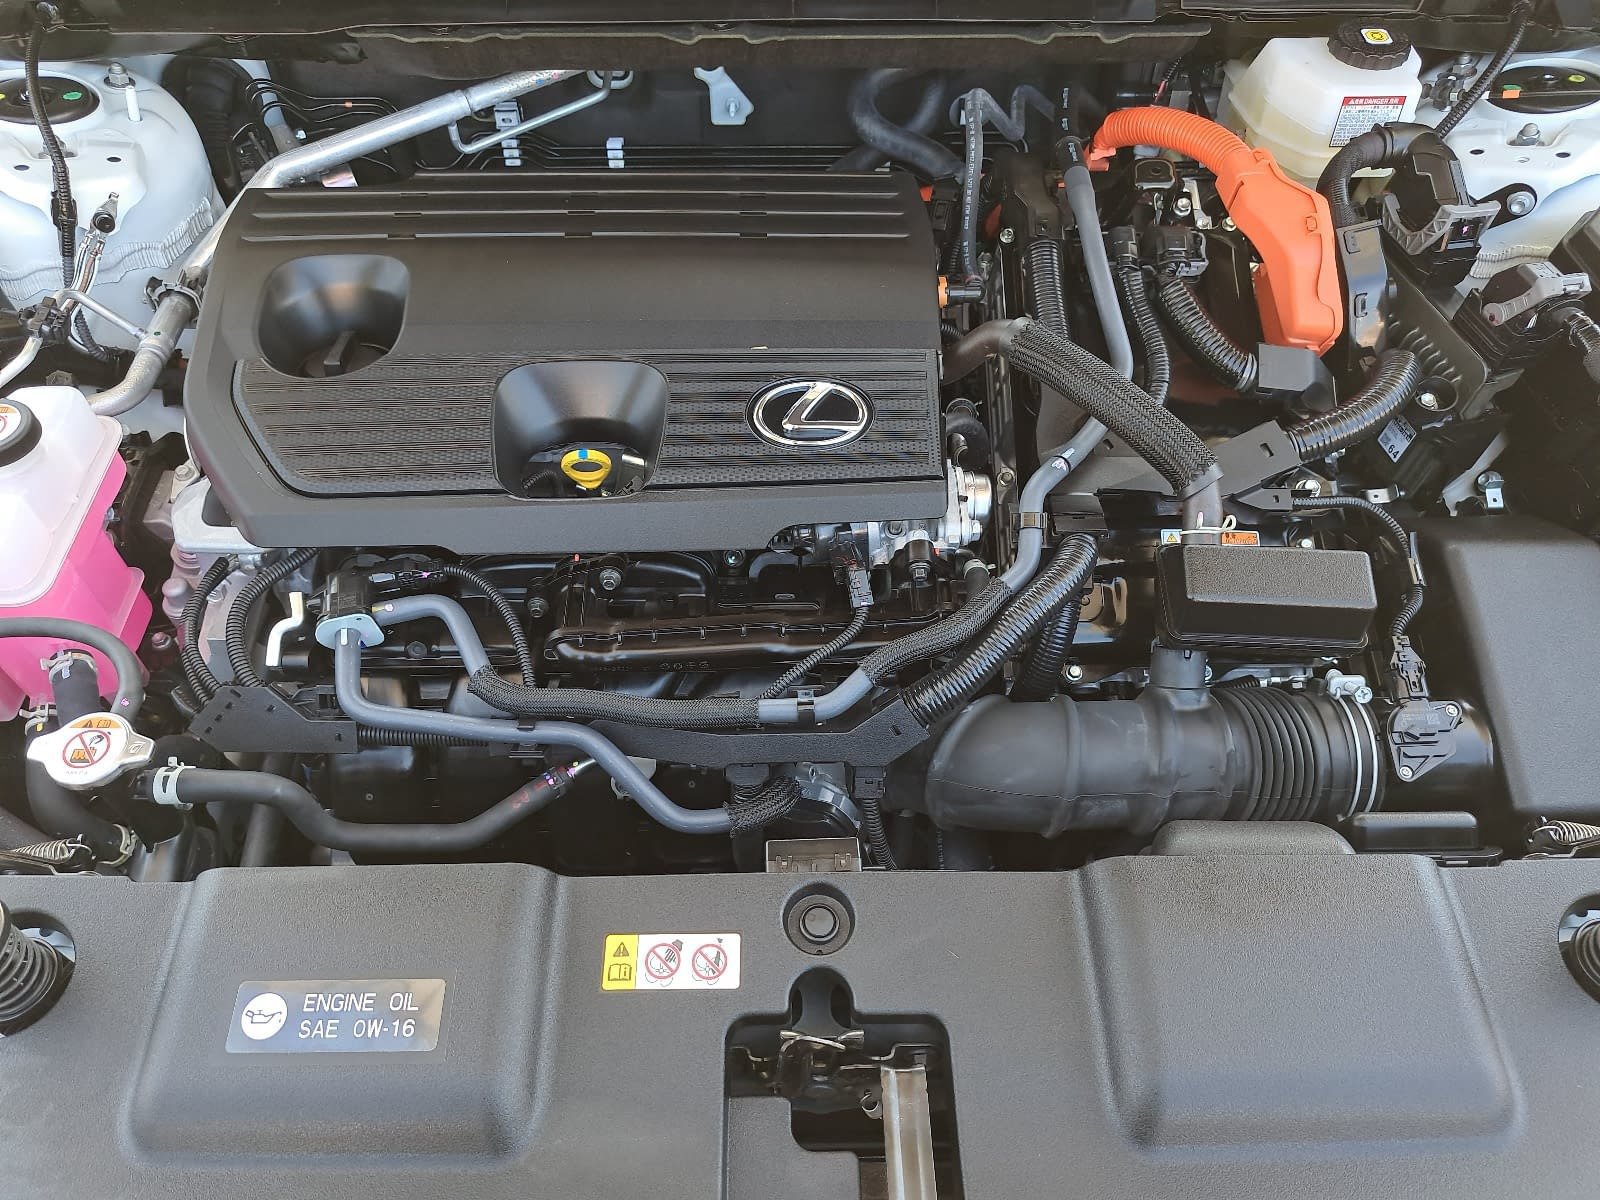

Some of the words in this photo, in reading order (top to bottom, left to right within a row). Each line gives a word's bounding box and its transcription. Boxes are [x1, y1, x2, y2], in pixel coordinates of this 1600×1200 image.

[303, 992, 376, 1012] ENGINE
[389, 992, 419, 1011] OIL
[298, 1019, 340, 1039] SAE
[353, 1018, 416, 1039] 0W-16
